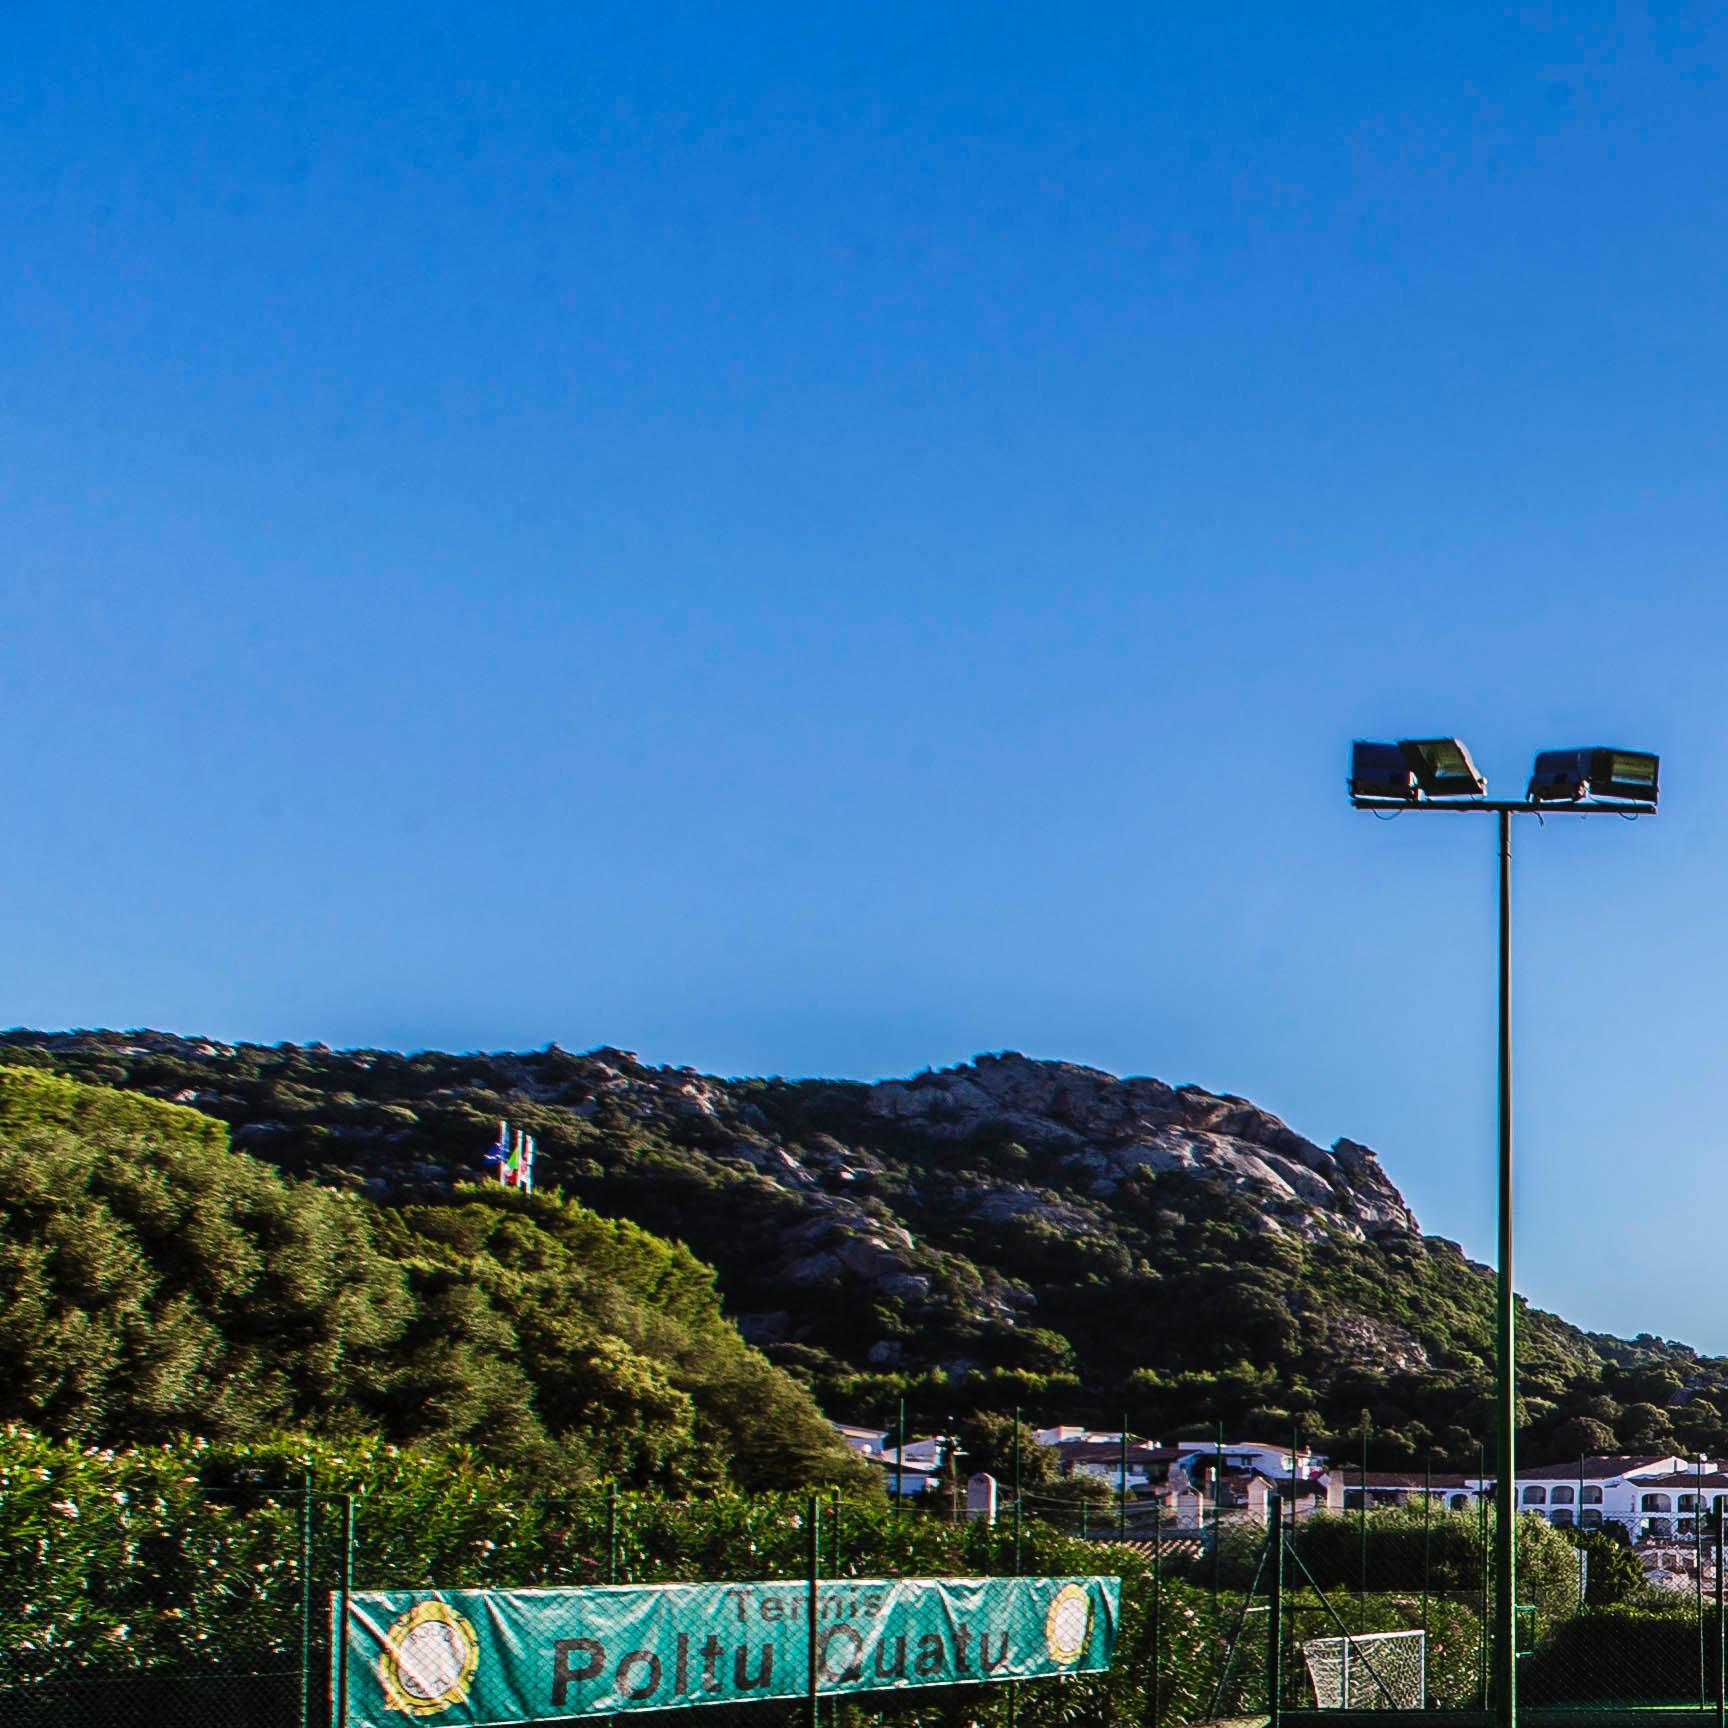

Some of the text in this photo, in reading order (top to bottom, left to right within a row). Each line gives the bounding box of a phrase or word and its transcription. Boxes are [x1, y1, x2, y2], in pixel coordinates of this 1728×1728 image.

[727, 1589, 882, 1622] Tennis
[551, 1623, 1009, 1707] Poltu Quatu
